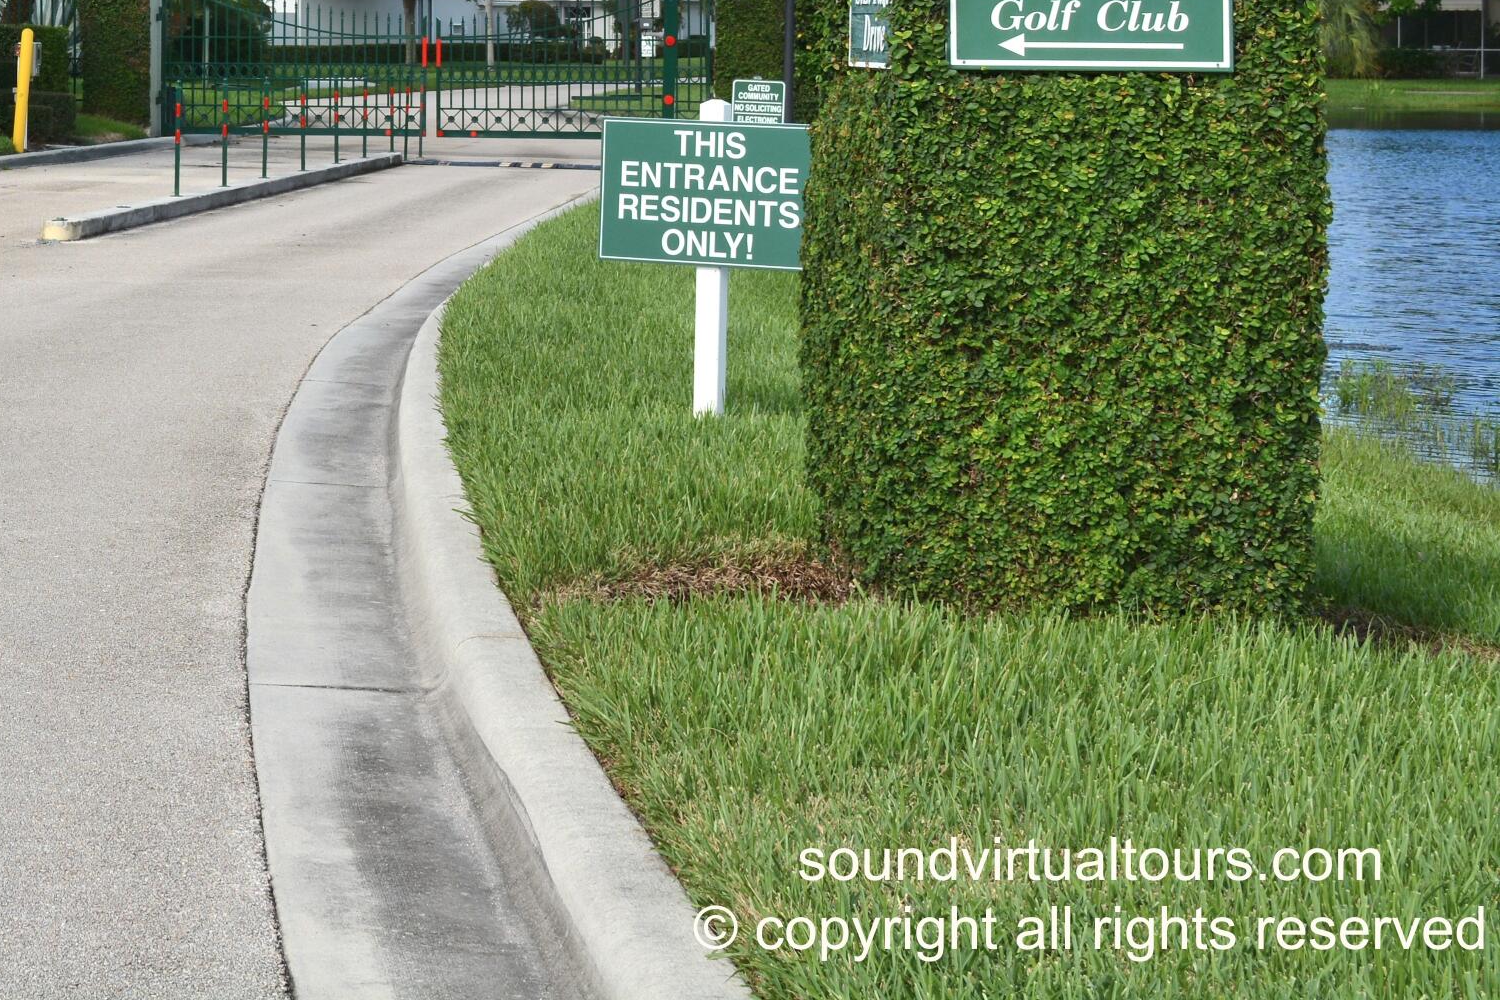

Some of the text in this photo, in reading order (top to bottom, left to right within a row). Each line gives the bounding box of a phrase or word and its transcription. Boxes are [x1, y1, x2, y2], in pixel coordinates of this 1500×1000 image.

[1097, 0, 1189, 32] Club
[863, 14, 886, 53] Drive
[738, 92, 779, 101] COMMUNITY
[748, 84, 771, 92] GATED
[735, 103, 782, 113] NO SOLICITING
[737, 115, 778, 124] ELECTRONIC
[674, 130, 747, 160] THIS
[620, 160, 800, 195] ENTRANCE
[618, 193, 801, 229] RESIDENTS
[661, 228, 754, 260] ONLY!
